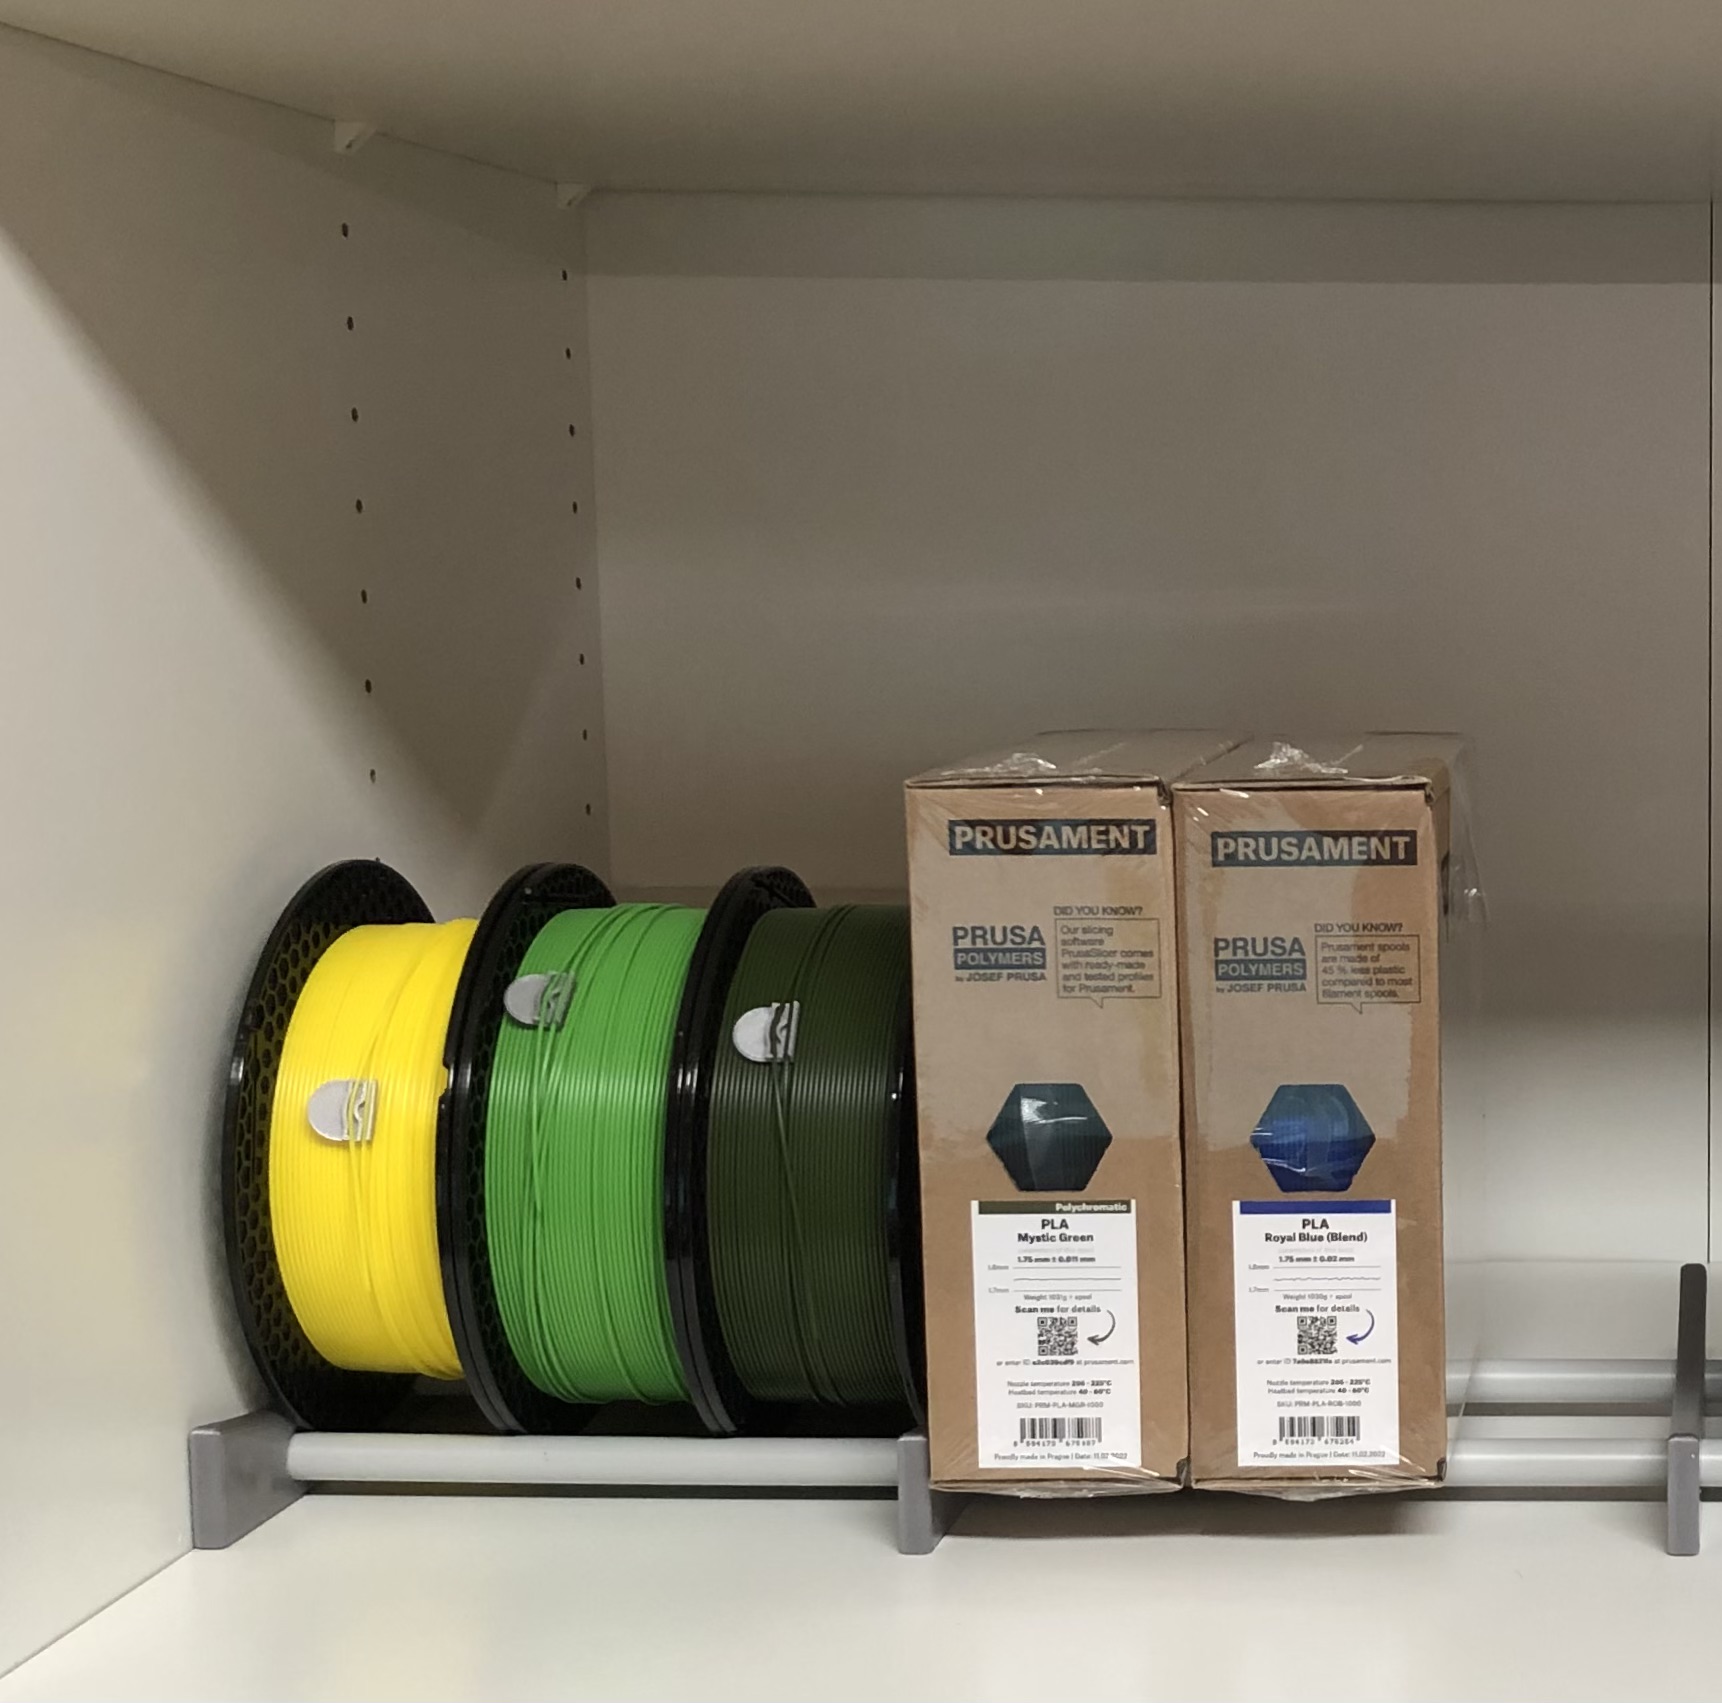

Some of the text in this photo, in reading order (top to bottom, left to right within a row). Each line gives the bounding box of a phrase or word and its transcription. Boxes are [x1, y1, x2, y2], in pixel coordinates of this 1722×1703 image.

[953, 824, 1151, 851] PRUSAMENT
[1217, 836, 1411, 862] PRUSAMENT
[1054, 906, 1143, 916] DID YOU KNOW?
[1061, 925, 1113, 936] Our slicing
[1314, 923, 1403, 933] DID YOU KNOW?
[952, 925, 1045, 946] PRUSA
[1061, 937, 1104, 946] software
[1214, 937, 1306, 957] PRUSA
[1321, 942, 1410, 952] Prusament spools
[957, 952, 1043, 965] POLYMERS
[1061, 949, 1117, 958] PrusaSlicer
[1339, 954, 1368, 963] made
[1370, 954, 1380, 963] of
[1062, 961, 1145, 971] with ready-made
[1218, 963, 1303, 976] POLYMERS
[1351, 966, 1370, 974] less
[1373, 966, 1405, 975] plastic
[966, 973, 1002, 981] JOSEF
[1007, 972, 1047, 981] PRUSA
[1062, 972, 1154, 983] and tested profiles
[1063, 983, 1135, 992] for Prusament.
[1322, 978, 1412, 987] compared to most
[1227, 984, 1263, 993] JOSEF
[1267, 983, 1306, 992] PRUSA
[1323, 989, 1361, 998] filament
[1055, 1203, 1127, 1212] Polychromatic
[1041, 1218, 1069, 1230] PLA
[1302, 1218, 1329, 1229] PLA
[1018, 1233, 1094, 1244] Mystic Green
[1265, 1232, 1368, 1244] Royal Blue (Blend)
[1283, 1293, 1306, 1301] Weight
[1057, 1305, 1068, 1313] for
[1071, 1305, 1101, 1313] details
[1275, 1305, 1298, 1313] Scan
[994, 1453, 1018, 1461] Proudly
[1047, 1453, 1069, 1461] Prague
[1253, 1452, 1277, 1460] Proudly
